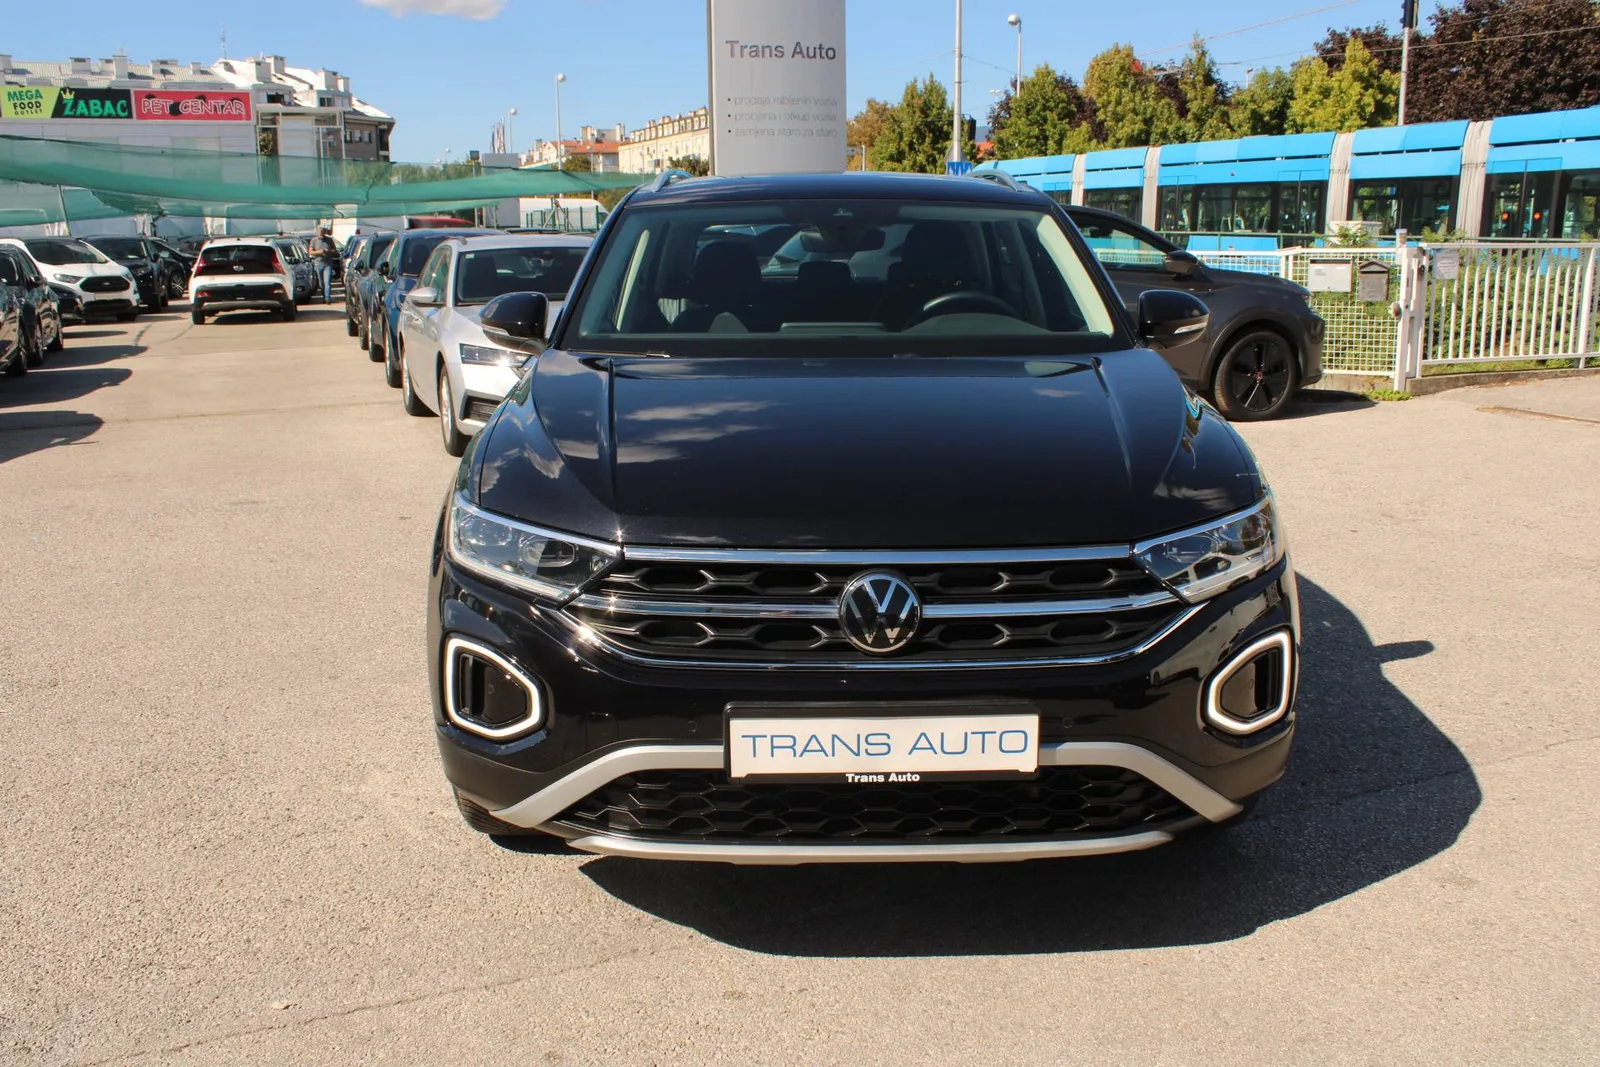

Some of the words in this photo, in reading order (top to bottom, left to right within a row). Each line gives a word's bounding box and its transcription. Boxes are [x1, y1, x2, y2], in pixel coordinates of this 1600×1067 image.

[725, 40, 785, 59] Trans
[791, 41, 837, 61] Auto
[7, 89, 44, 102] MEGA
[13, 100, 42, 111] FOOD
[14, 108, 43, 116] OUTLET
[141, 98, 174, 115] PET
[179, 98, 246, 116] CENTAR
[741, 732, 892, 759] TRANS
[908, 729, 1029, 756] AUTO
[846, 773, 885, 783] Trans
[888, 772, 921, 783] Auto
